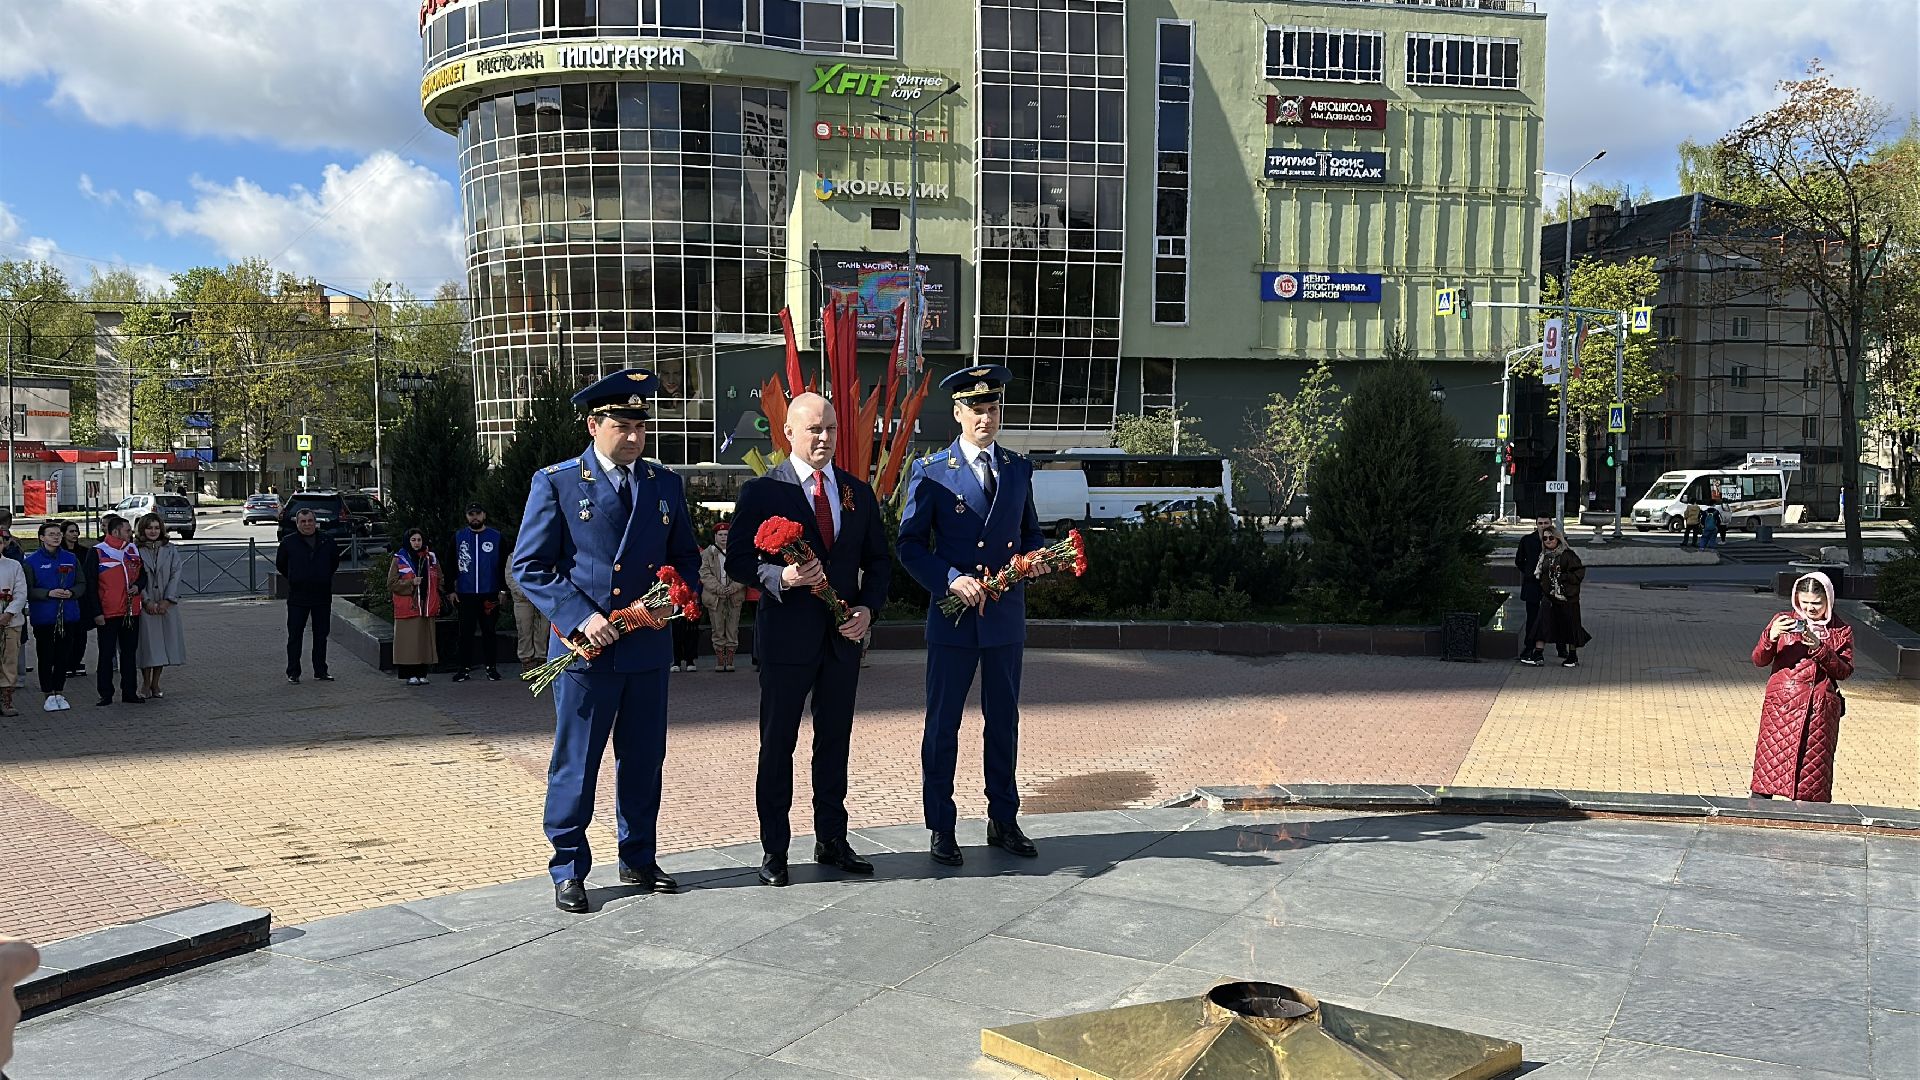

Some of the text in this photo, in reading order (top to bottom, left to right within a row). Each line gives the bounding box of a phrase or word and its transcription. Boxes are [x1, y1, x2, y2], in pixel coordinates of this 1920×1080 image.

[557, 44, 685, 66] ТИПОГРАФИЯ
[477, 51, 545, 75] РЕСТОРАН
[808, 63, 891, 97] XFIT
[896, 73, 943, 86] фитнес
[891, 87, 922, 100] клуб
[1309, 101, 1373, 113] АВТОШКОЛА
[837, 125, 949, 142] SUNLIGHT
[1268, 155, 1317, 167] ТРИУМФ
[1329, 157, 1365, 167] ОФИС
[1329, 167, 1382, 178] ПРОДАЖ
[837, 179, 949, 199] КОРАБЛИК
[1303, 274, 1331, 283] ЦЕНТР
[1303, 283, 1366, 292] ИНОСТРАННЫХ
[1303, 291, 1340, 299] ЯЗЫКОВ
[1546, 327, 1557, 349] 9
[1549, 482, 1565, 490] СТОП
